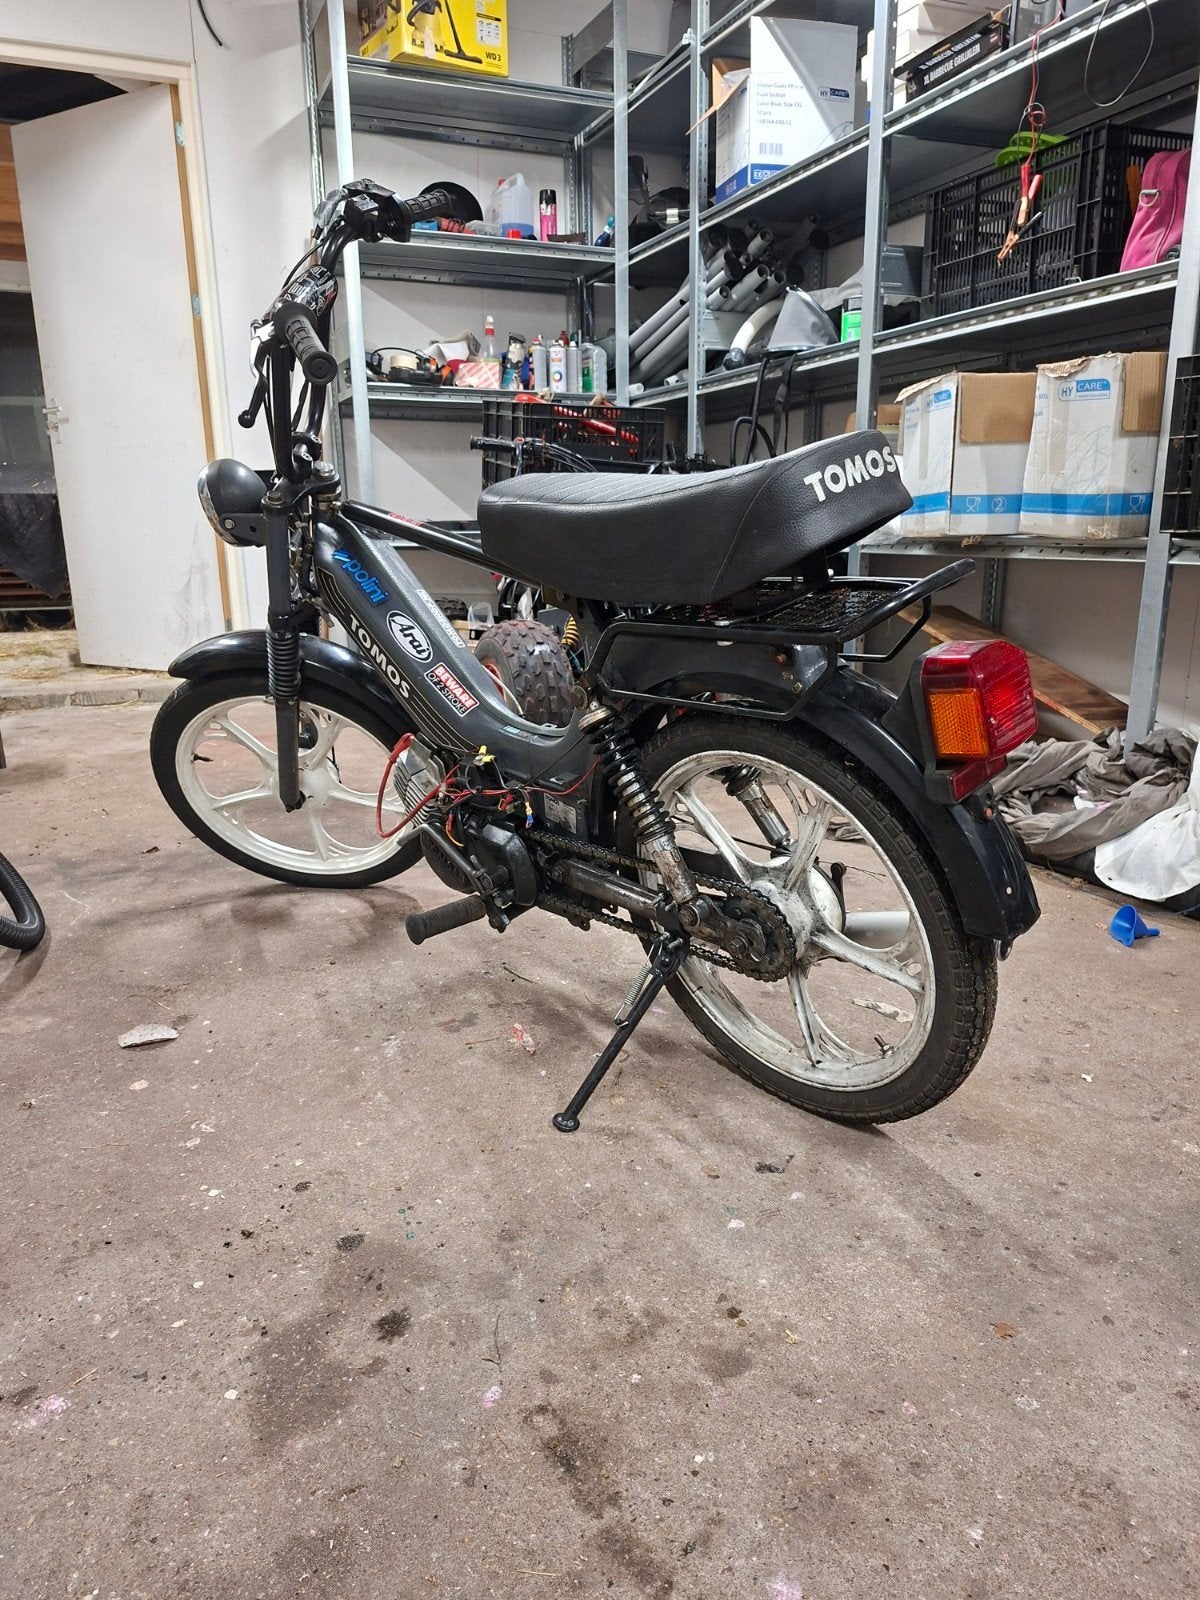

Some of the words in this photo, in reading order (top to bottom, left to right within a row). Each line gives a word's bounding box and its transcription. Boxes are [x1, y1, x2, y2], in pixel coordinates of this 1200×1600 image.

[485, 51, 497, 60] WD
[929, 59, 955, 83] BARBECUE
[830, 88, 848, 98] CARE
[934, 391, 950, 403] CARE
[1061, 386, 1073, 397] HY
[1077, 380, 1104, 392] CARE
[803, 446, 897, 502] TOMOS
[341, 559, 390, 604] polini
[389, 617, 431, 655] Arai
[349, 614, 411, 699] TOMOS
[428, 672, 440, 682] OF
[441, 686, 467, 714] STROKE
[433, 665, 477, 708] BEWARE
